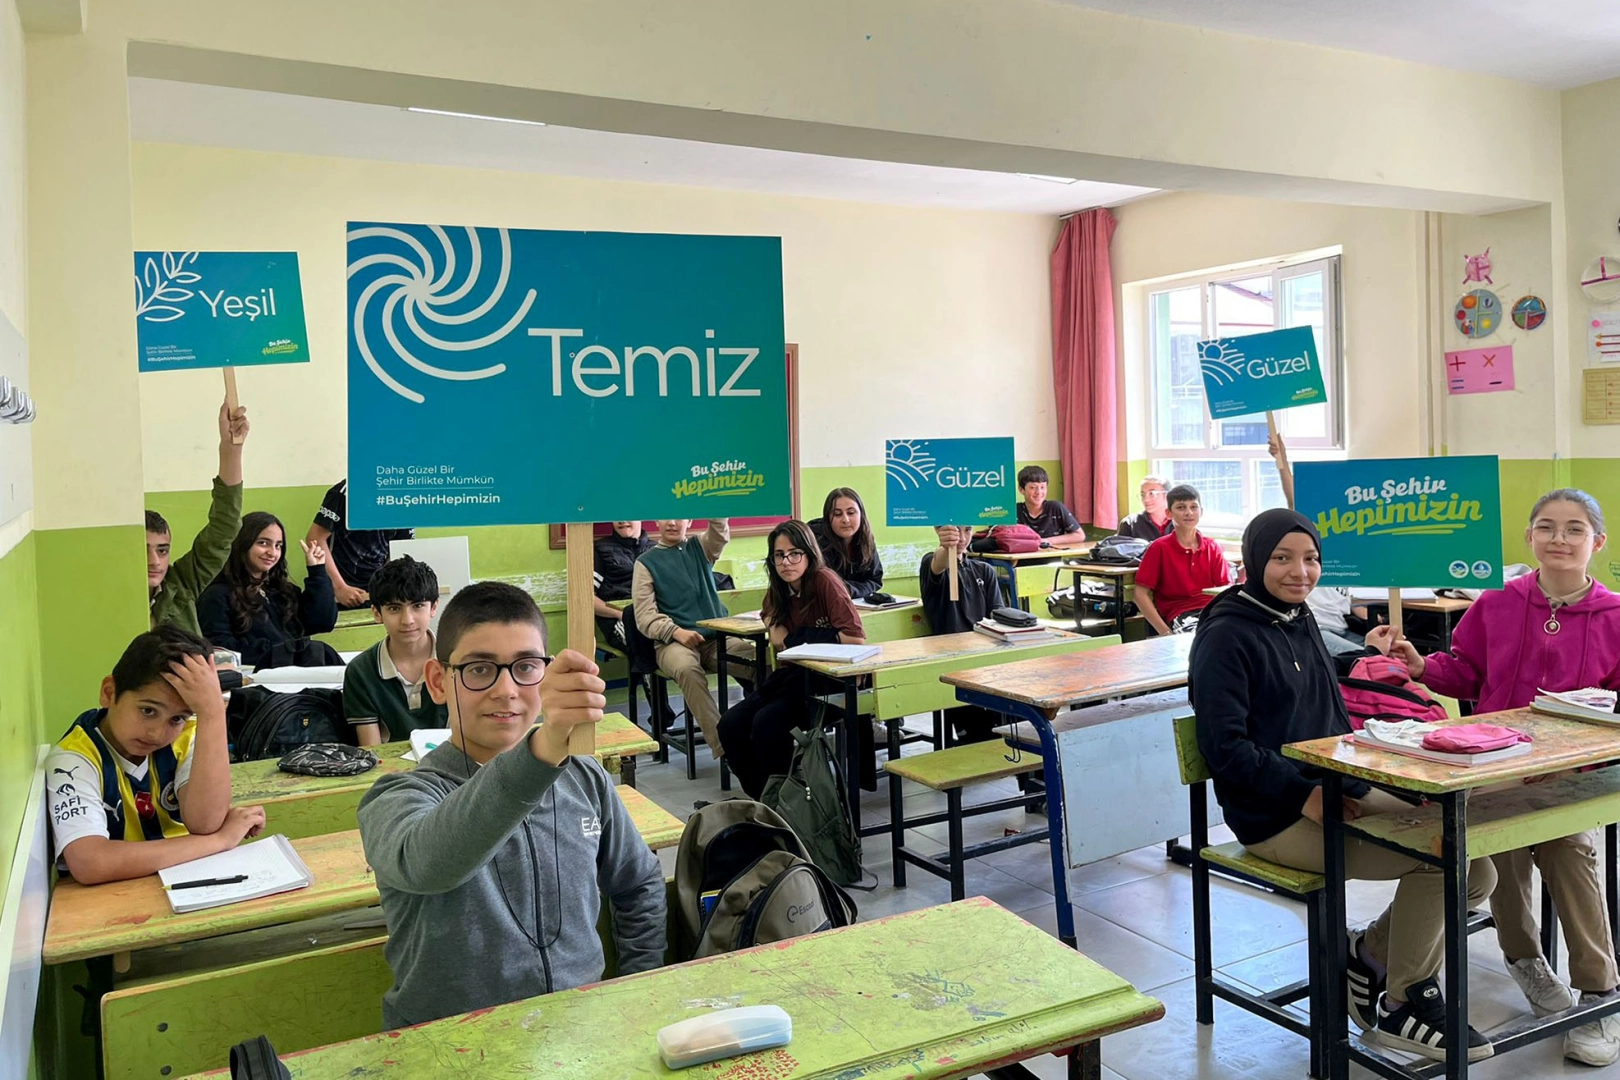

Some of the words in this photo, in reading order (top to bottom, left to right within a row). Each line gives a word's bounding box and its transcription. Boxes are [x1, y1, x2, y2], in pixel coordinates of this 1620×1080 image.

[198, 288, 276, 322] Yeşil
[527, 328, 761, 397] Temiz
[1247, 350, 1311, 379] Güzel
[376, 465, 405, 475] Daha
[407, 465, 438, 475] Güzel
[440, 465, 455, 474] Bir
[376, 476, 404, 487] Şehir
[406, 475, 444, 485] Birlikte
[446, 475, 495, 485] Mümkün
[691, 465, 709, 477] Bu
[711, 460, 746, 476] Şehir
[936, 465, 1005, 488] Güzel
[671, 469, 765, 499] Hepimizin
[1344, 486, 1378, 505] Bu
[1380, 476, 1447, 504] Şehir
[376, 493, 500, 507] #BuŞehirHepimizin
[1312, 493, 1483, 539] Hepimizin
